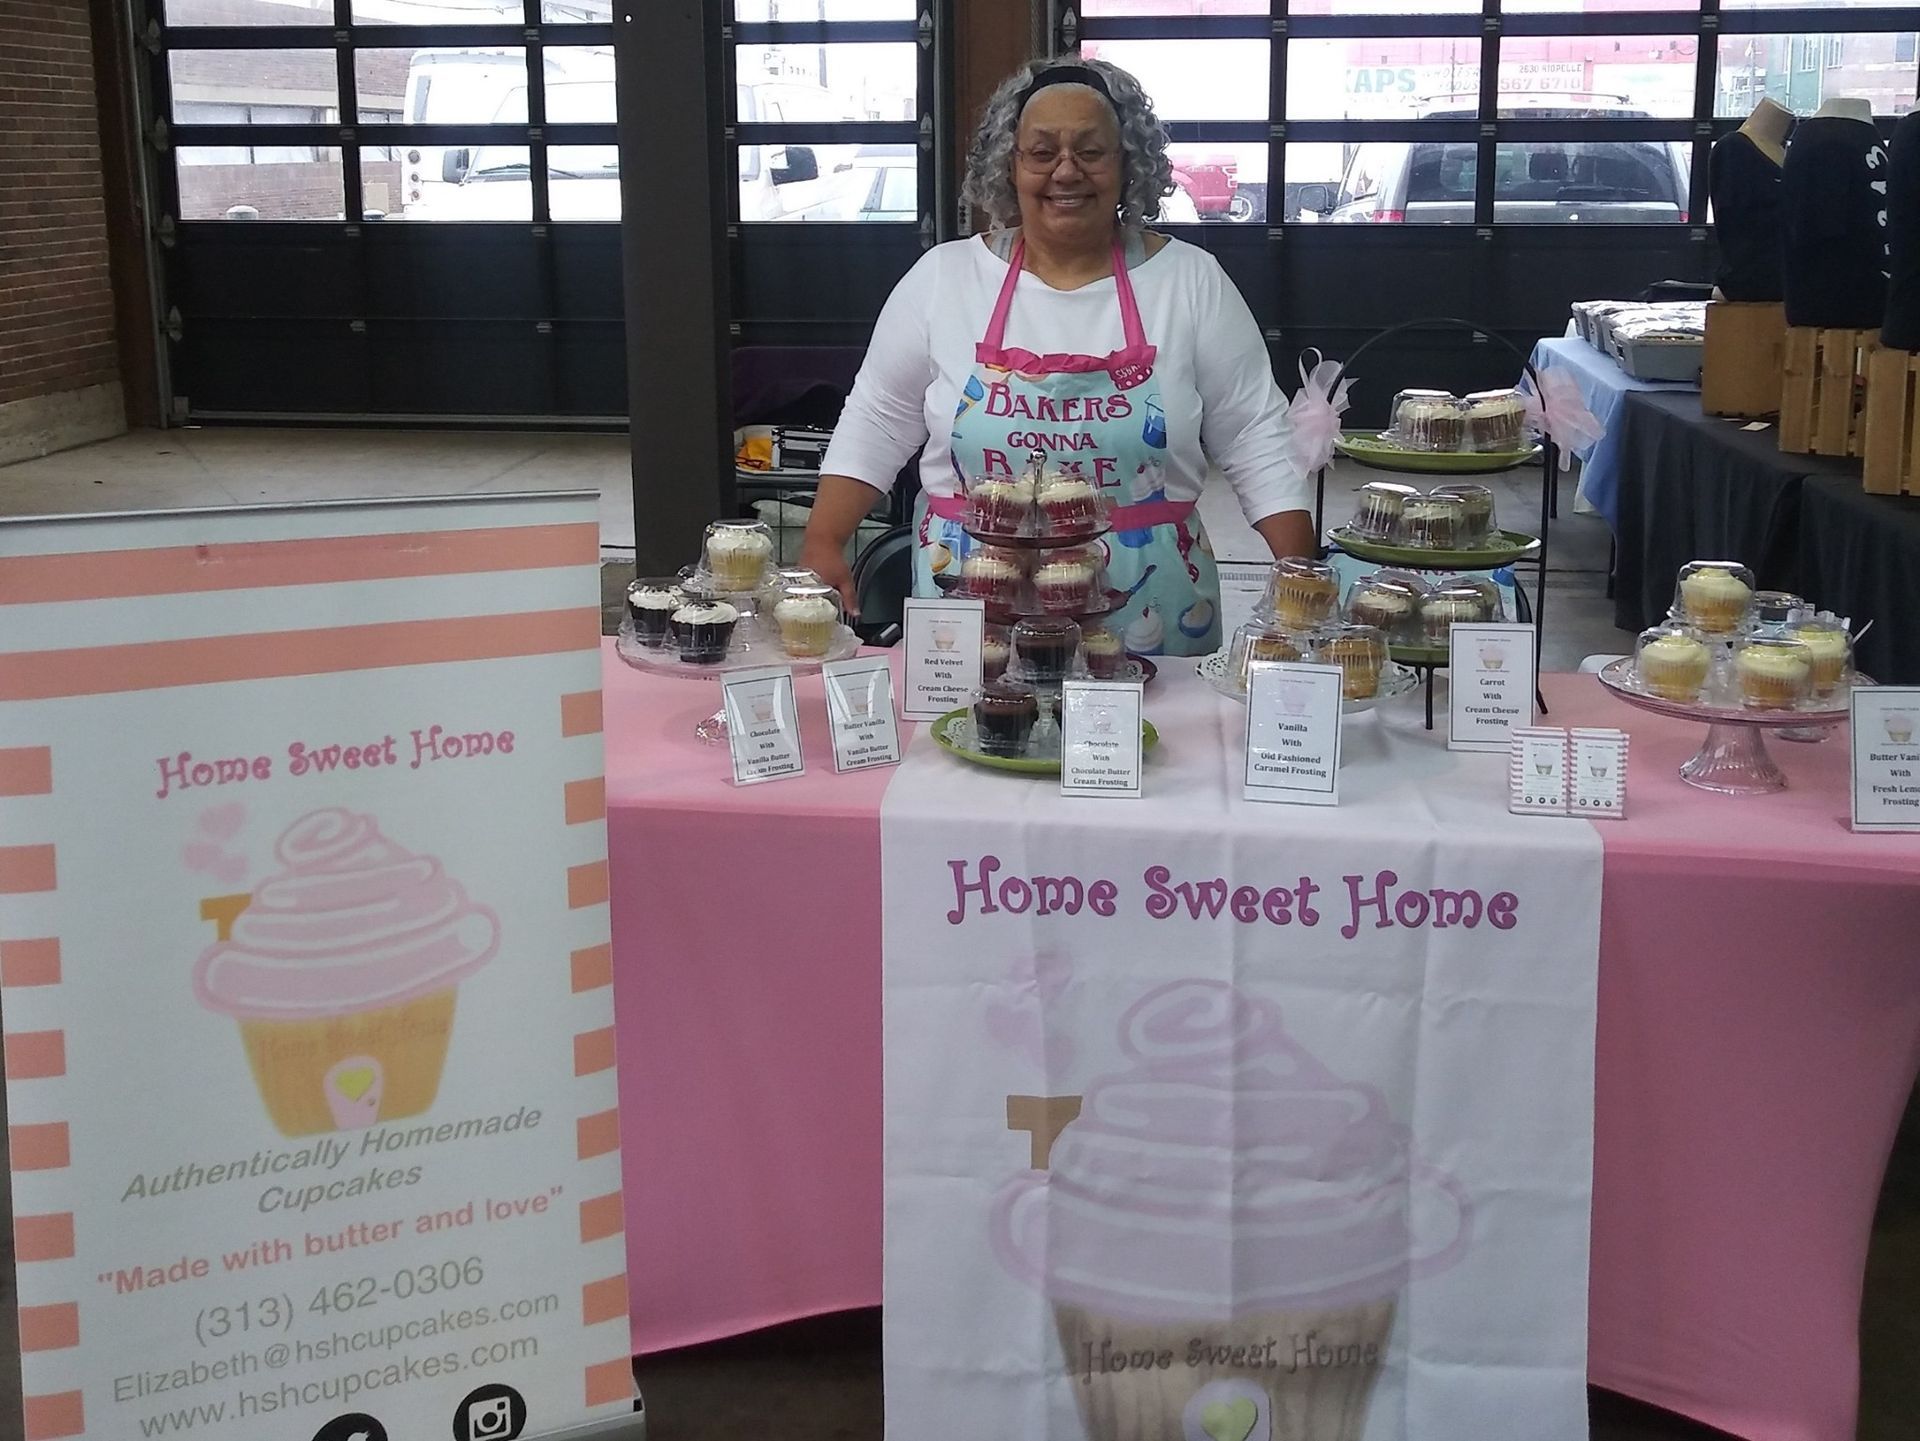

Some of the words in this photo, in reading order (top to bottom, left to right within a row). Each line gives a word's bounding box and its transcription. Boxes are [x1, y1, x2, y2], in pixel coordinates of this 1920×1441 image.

[984, 382, 1133, 422] BAKERS
[1007, 431, 1098, 451] GONNA
[924, 658, 939, 666] Red
[941, 658, 963, 666] Velvet
[934, 671, 952, 679] With
[1480, 678, 1505, 686] Carrot
[943, 685, 968, 693] Cheese
[928, 695, 958, 704] Frosting
[1483, 692, 1502, 700] With
[1465, 706, 1490, 714] Cream
[1492, 706, 1519, 714] Cheese
[1476, 717, 1509, 726] Frosting
[1278, 722, 1308, 732] Vanilla
[1281, 738, 1302, 747] With
[156, 754, 272, 799] Home
[288, 735, 398, 776] Sweet
[410, 724, 516, 769] Home
[846, 758, 866, 767] Cream
[867, 753, 892, 763] Frosting
[1277, 753, 1321, 764] Fashioned
[1869, 753, 1898, 761] Butter
[1071, 767, 1105, 775] Chocolate
[1254, 763, 1289, 773] Caramel
[1291, 767, 1327, 778] Frosting
[1890, 769, 1911, 777] With
[1073, 777, 1096, 785] Cream
[1098, 778, 1128, 787] Frosting
[1872, 785, 1898, 793] Fresh
[1882, 797, 1920, 807] Frosting
[947, 855, 1118, 925] Home
[1143, 865, 1321, 927] Sweet
[1340, 870, 1519, 939] Home
[121, 1137, 350, 1203] Authentically
[360, 1105, 542, 1158] Homemade
[258, 1163, 423, 1215] Cupcakes
[98, 1256, 210, 1295] "Made
[222, 1240, 293, 1272] with
[305, 1216, 404, 1257] butter
[415, 1202, 475, 1235] and
[486, 1185, 564, 1222] love"
[194, 1293, 295, 1347] (313)
[308, 1256, 484, 1314] 462-0306
[113, 1291, 559, 1402] Elizabeth@hshcupcakes.com
[1081, 1337, 1174, 1385] Home
[1186, 1336, 1278, 1371] Sweet
[1286, 1329, 1379, 1374] Home
[140, 1334, 539, 1438] www.hshcupcakes.com
